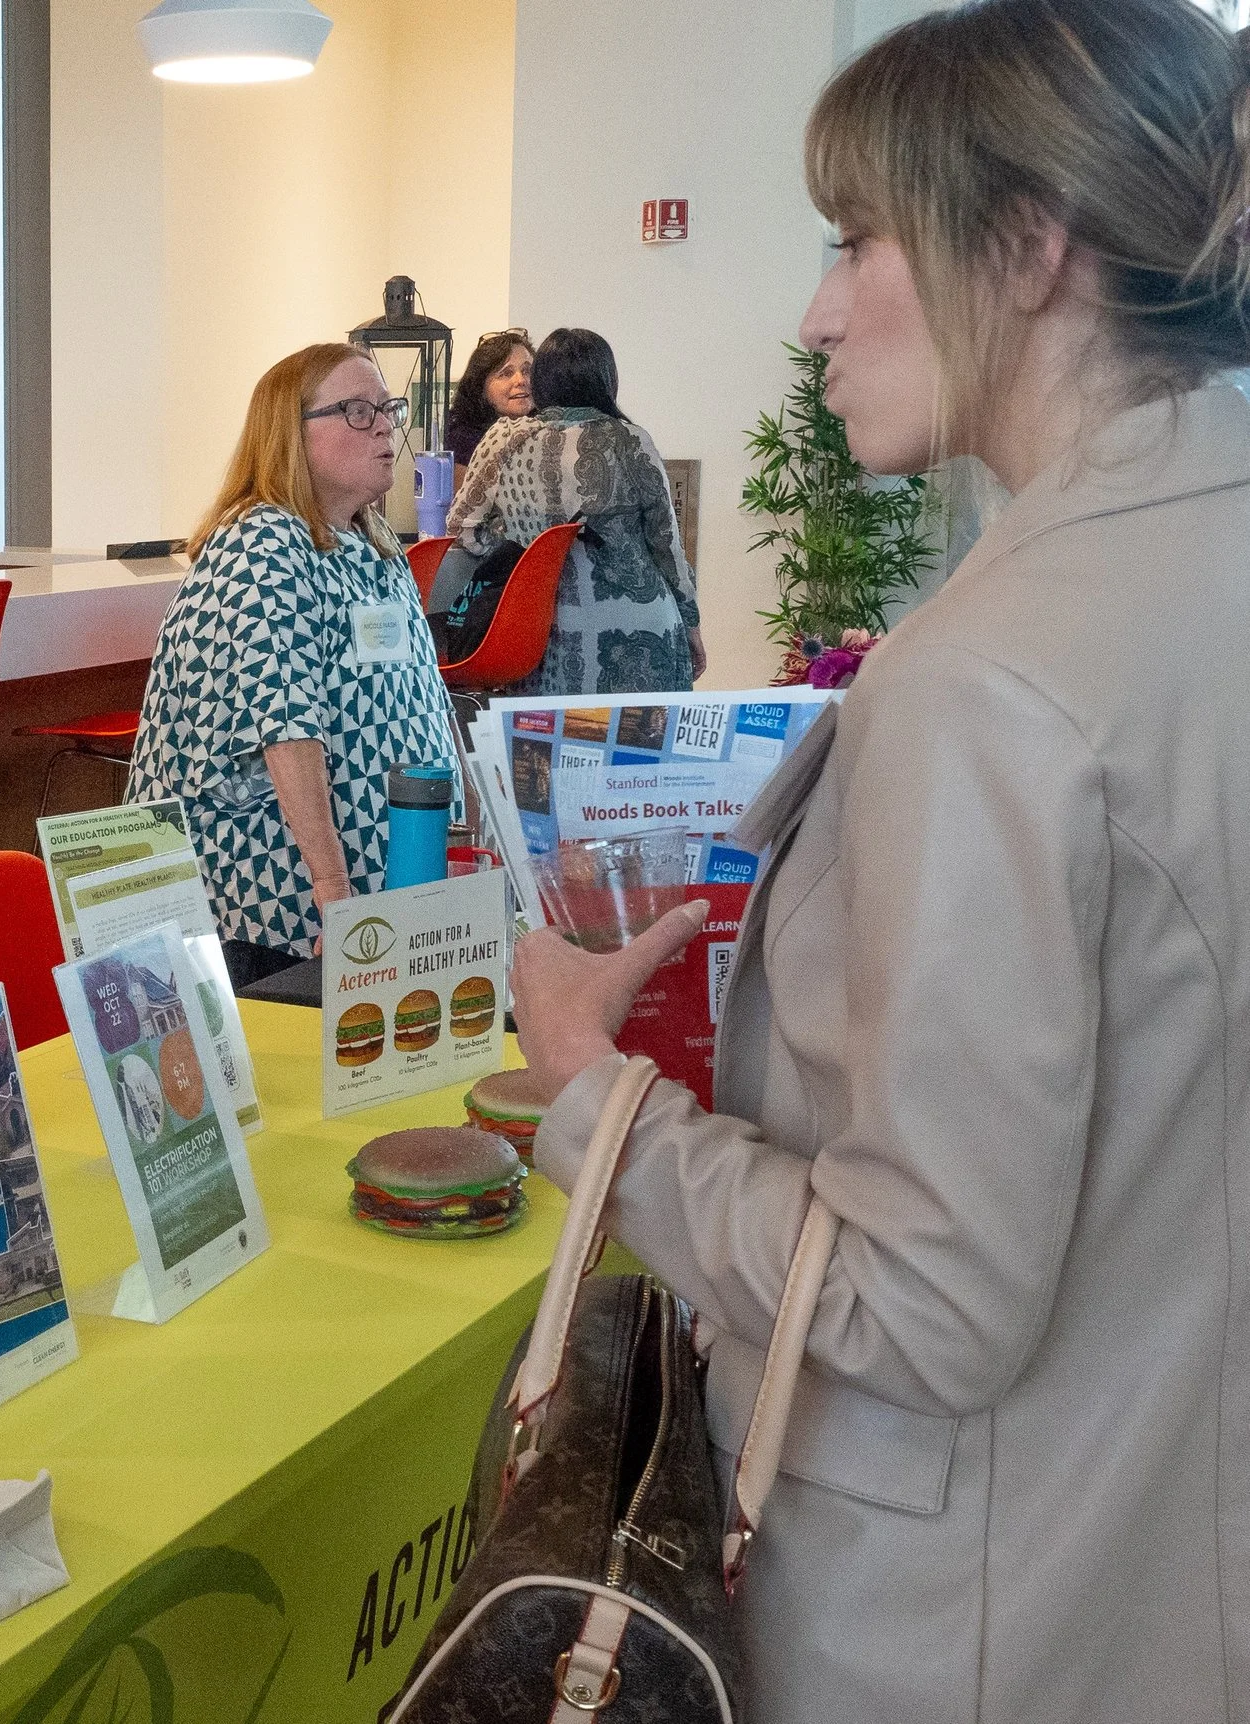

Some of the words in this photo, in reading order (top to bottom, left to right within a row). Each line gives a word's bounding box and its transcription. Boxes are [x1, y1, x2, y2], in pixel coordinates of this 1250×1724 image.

[745, 703, 784, 717] LIQUID
[745, 715, 780, 729] ASSET
[675, 726, 719, 749] PLIER
[605, 776, 658, 790] Stanford
[582, 803, 639, 822] Woods
[643, 801, 690, 818] Book
[694, 799, 744, 817] Talks
[50, 834, 68, 846] OUR
[69, 826, 117, 842] EDUCATION
[118, 820, 162, 835] PROGRAMS
[713, 861, 751, 875] LIQUID
[409, 928, 442, 950] ACTION
[446, 924, 462, 942] FOR
[465, 923, 471, 938] A
[409, 949, 456, 977] HEALTHY
[459, 940, 499, 965] PLANET
[337, 965, 398, 993] Acterra
[96, 982, 121, 1000] WED.
[103, 996, 121, 1013] OCT
[110, 1012, 122, 1027] 22
[454, 1035, 490, 1051] Plant-based
[406, 1053, 429, 1064] Poultry
[173, 1062, 186, 1078] 6-7
[351, 1067, 367, 1079] Beef
[177, 1077, 191, 1092] PM
[143, 1126, 218, 1181] ELECTRIFICATION
[147, 1176, 162, 1195] 101
[160, 1147, 212, 1186] WORKSHOP
[347, 1504, 472, 1683] ACTIO
